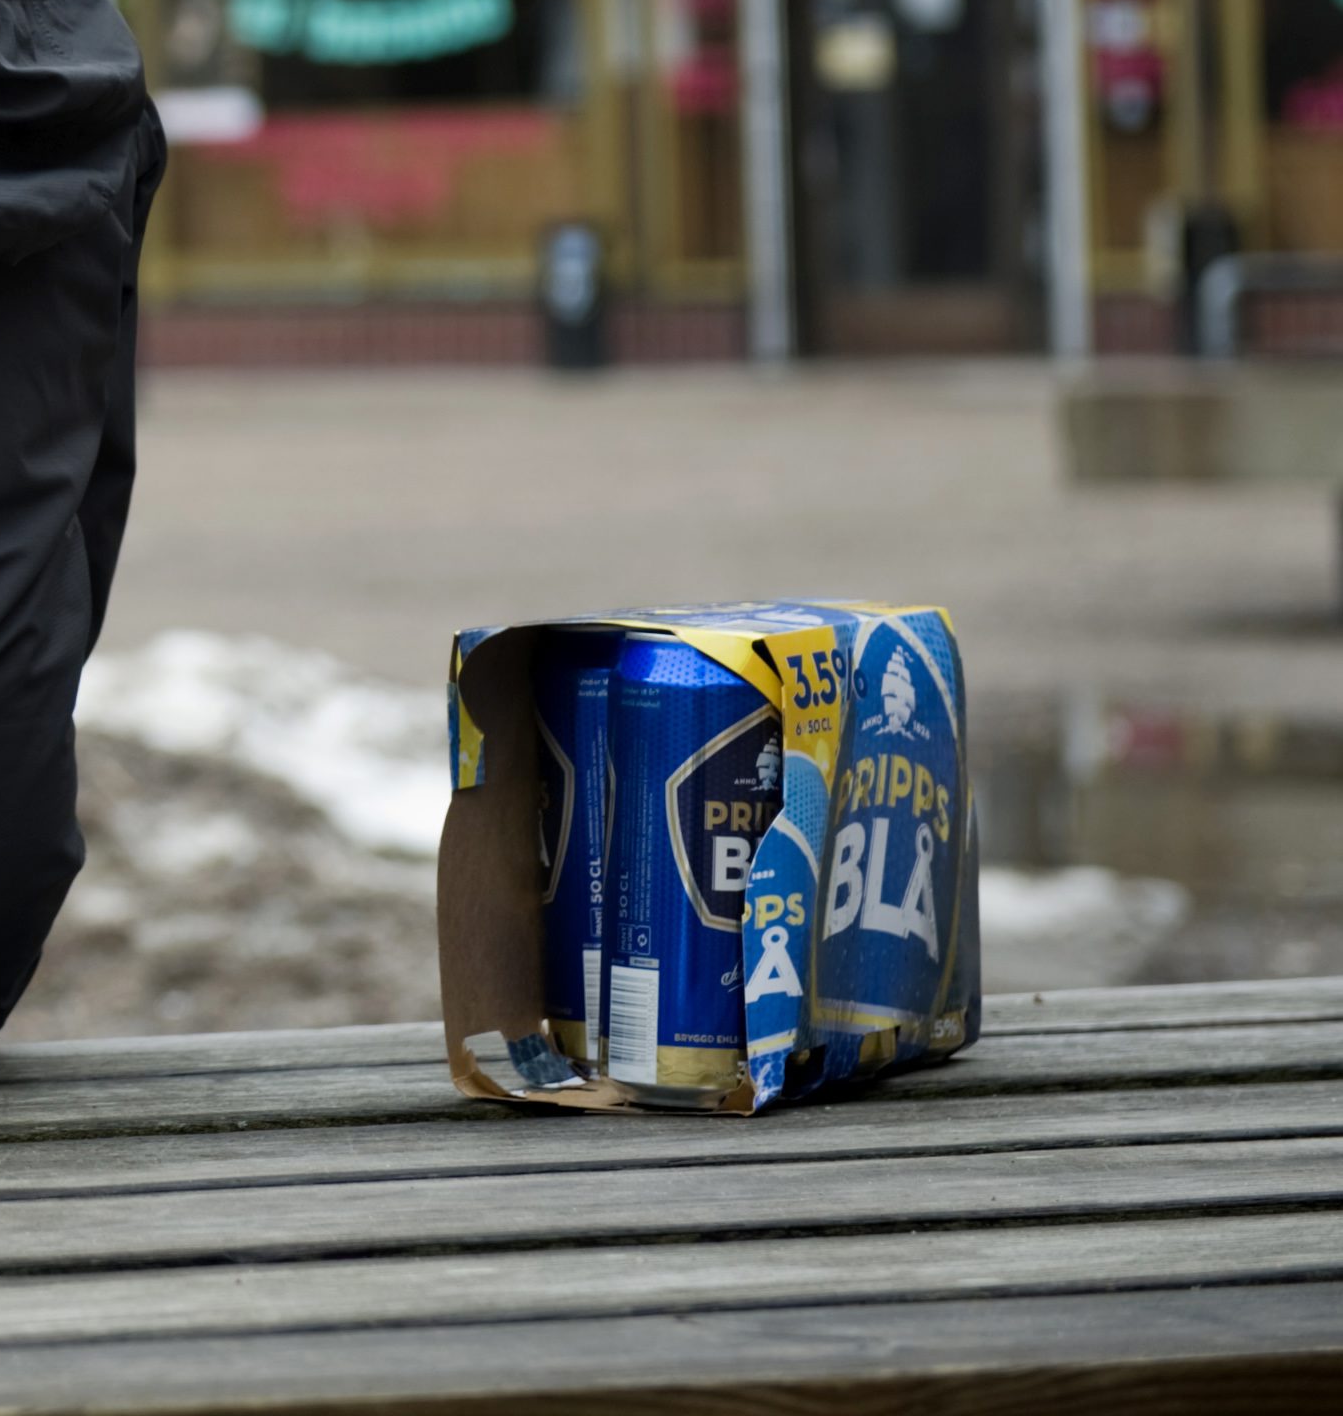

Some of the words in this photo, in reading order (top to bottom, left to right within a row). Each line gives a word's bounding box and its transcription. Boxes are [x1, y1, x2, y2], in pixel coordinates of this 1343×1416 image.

[786, 648, 868, 709] 3.5%
[834, 753, 950, 842] PRIPPS
[711, 835, 763, 892] B
[822, 817, 940, 964] BLÅ
[674, 1032, 715, 1043] BRYGGD
